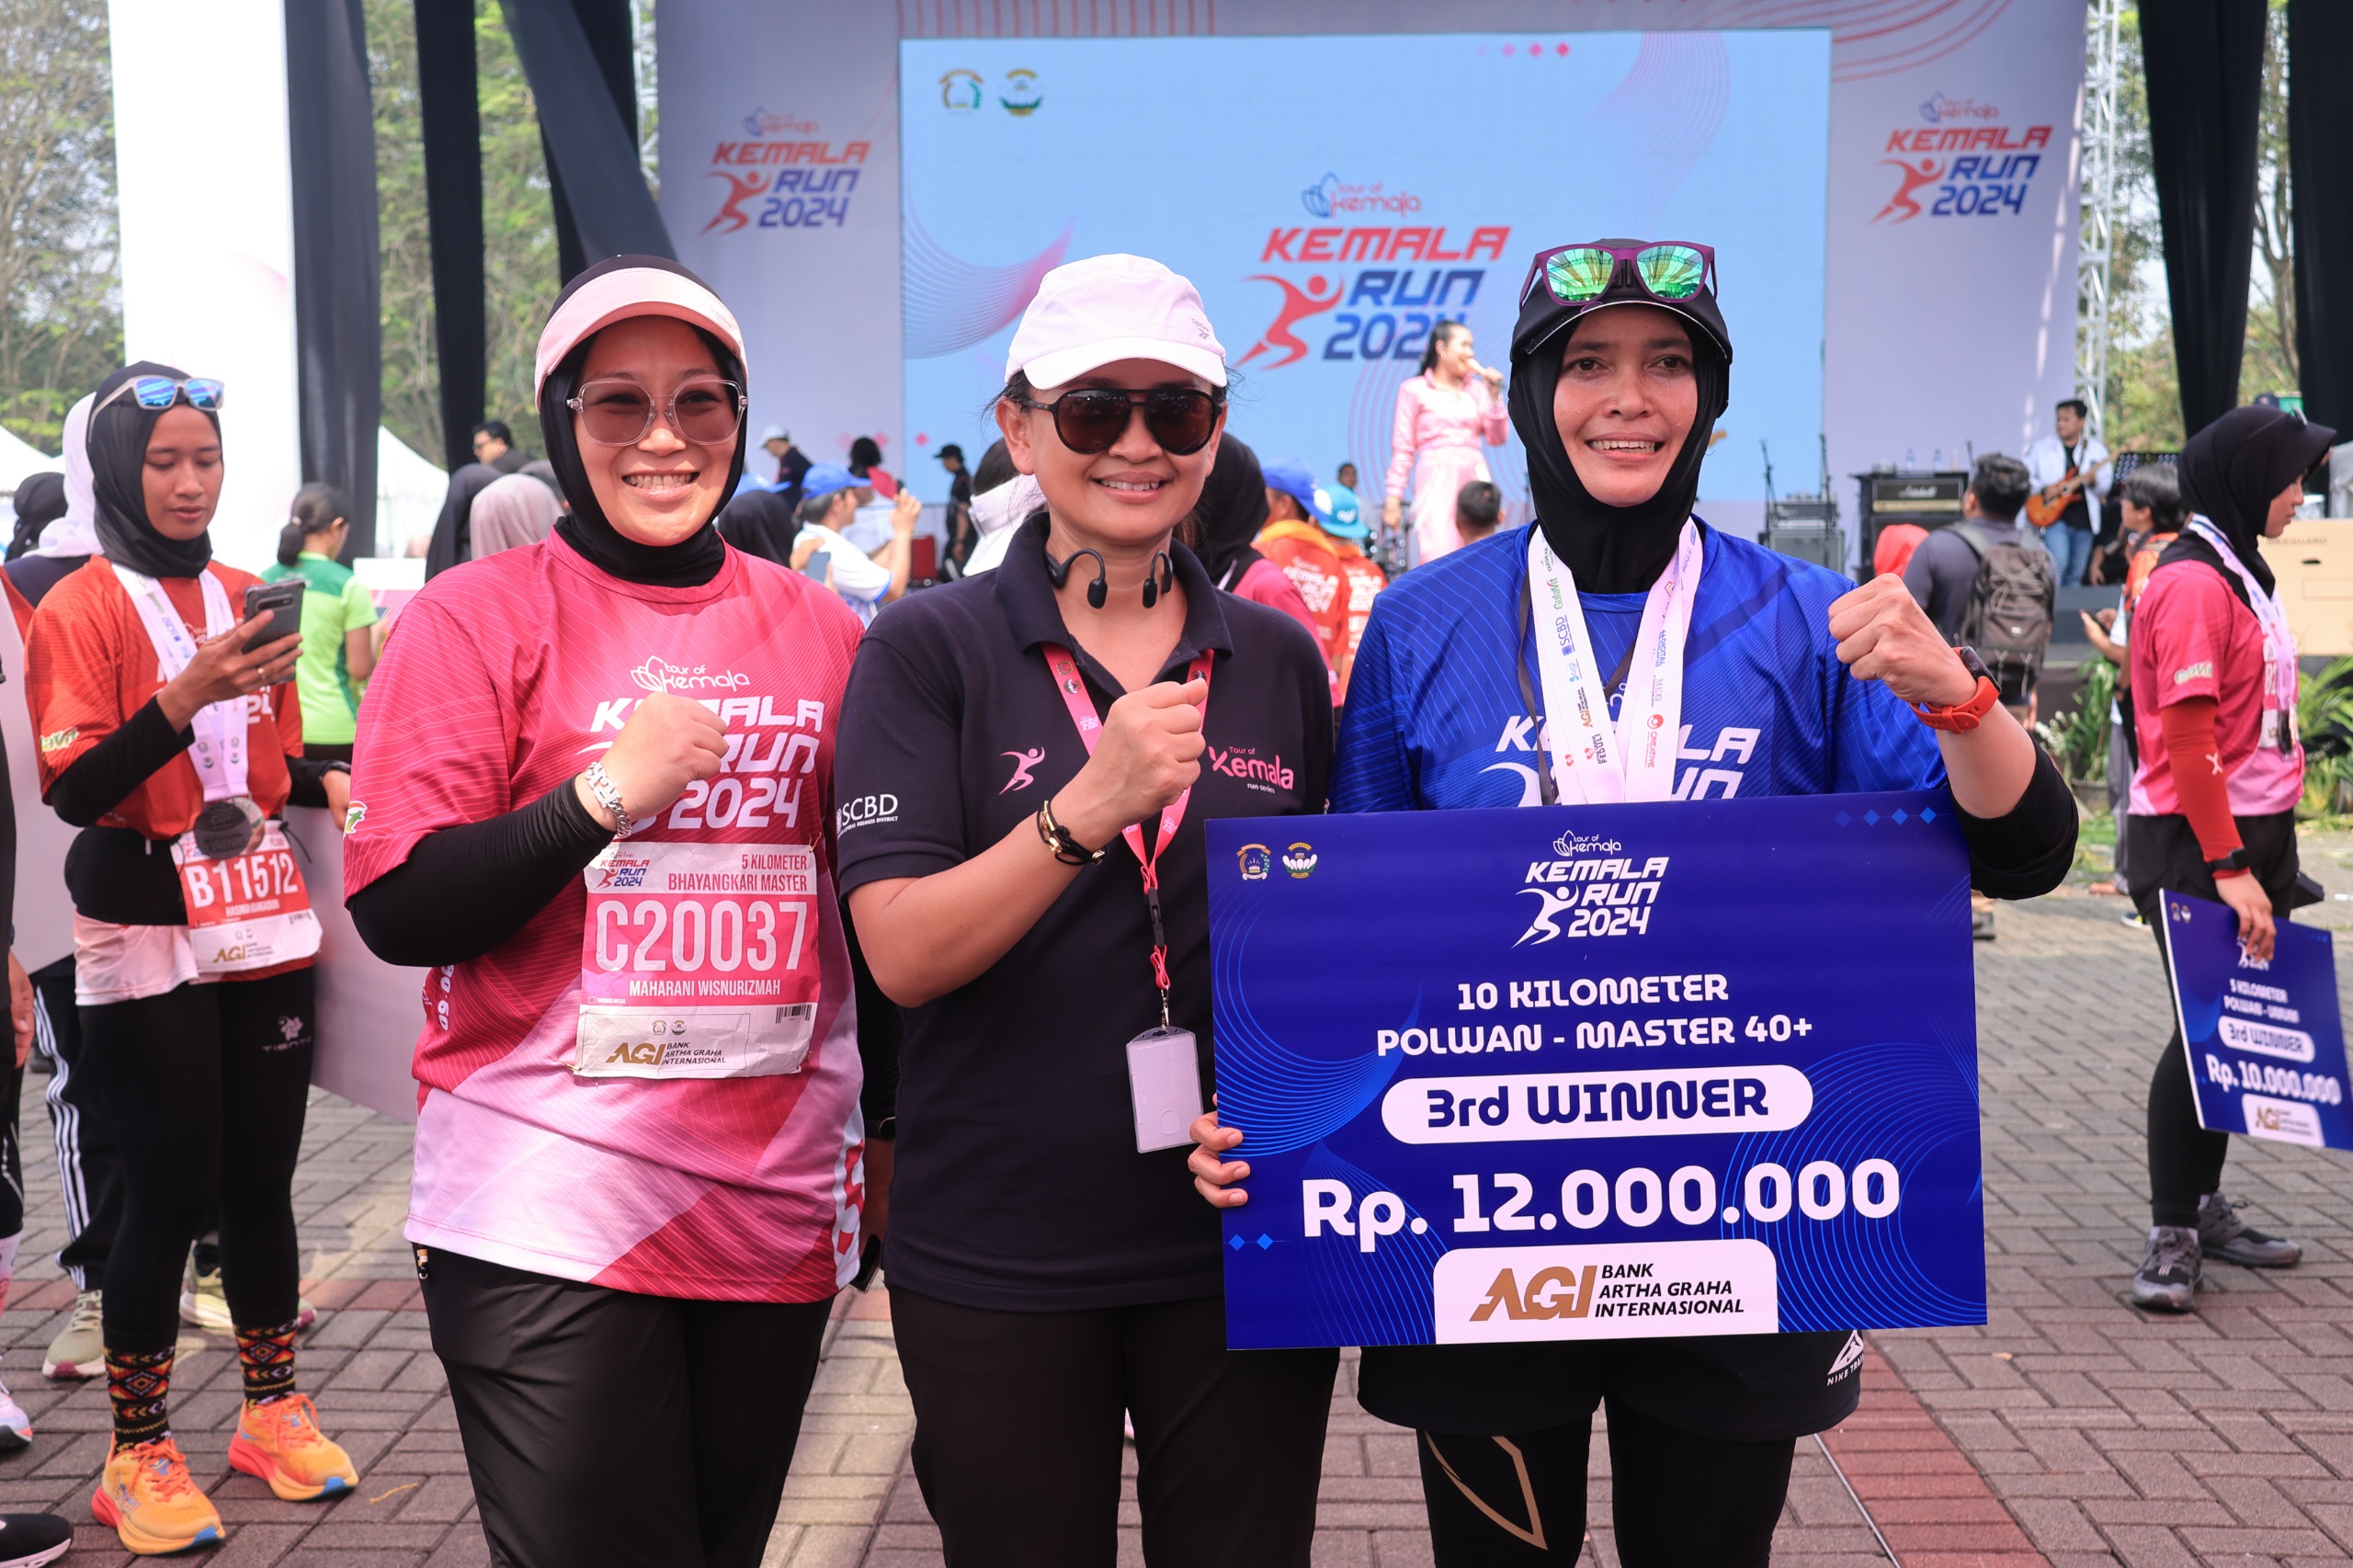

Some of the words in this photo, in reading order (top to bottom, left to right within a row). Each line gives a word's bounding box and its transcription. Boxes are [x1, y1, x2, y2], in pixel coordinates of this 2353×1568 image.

[1885, 126, 2052, 153] KEMALA
[712, 142, 871, 165] KEMALA
[1948, 154, 2041, 179] RUN
[773, 168, 860, 193] RUN
[1931, 184, 2029, 215] 2024
[756, 198, 851, 227] 2024
[1260, 226, 1511, 262] KEMALA
[1347, 269, 1486, 307] RUN
[1547, 576, 1563, 610] GulaVit
[1555, 617, 1571, 646] SCBD
[665, 663, 689, 676] tour
[693, 665, 707, 675] of
[1654, 678, 1664, 701] MEG
[1578, 710, 1593, 728] AGI
[1229, 746, 1245, 755] Tour
[1593, 733, 1607, 764] PEDULI
[1648, 731, 1658, 768] CREATIVE
[1208, 746, 1294, 790] Kemala
[1246, 782, 1259, 790] run
[1259, 784, 1276, 794] series
[668, 778, 802, 829] 2024
[843, 794, 898, 825] SCBD
[857, 818, 876, 826] BUSINESS
[1591, 834, 1599, 842] of
[742, 855, 748, 869] 5
[752, 855, 807, 870] KILOMETER
[1525, 857, 1669, 883] KEMALA
[185, 852, 299, 909] B11512
[614, 877, 643, 886] 2024
[668, 873, 758, 892] BHAYANGKARI
[761, 875, 807, 892] MASTER
[1581, 881, 1661, 906] RUN
[1567, 906, 1651, 938] 2024
[595, 900, 807, 972] C20037
[213, 945, 245, 963] AGI
[629, 980, 695, 997] MAHARANI
[698, 979, 781, 995] WISNURIZMAH
[1458, 983, 1497, 1010] 10
[1510, 974, 1728, 1009] KILOMETER
[667, 1041, 690, 1050] BANK
[1377, 1022, 1542, 1057] POLWAN
[1576, 1017, 1735, 1050] MASTER
[1745, 1015, 1813, 1042] 40+
[2228, 1024, 2248, 1042] 3rd
[2249, 1028, 2304, 1054] WINNER
[605, 1042, 666, 1065] AGI
[662, 1057, 726, 1065] INTERNASIONAL
[2205, 1053, 2240, 1093] Rp.
[2238, 1061, 2342, 1106] 10.000.000
[1427, 1086, 1510, 1129] 3rd
[1527, 1078, 1769, 1123] WINNER
[1303, 1179, 1428, 1253] Rp.
[1452, 1158, 1900, 1233] 12.000.000
[1601, 1263, 1654, 1278] BANK
[1469, 1265, 1597, 1322] AGI
[1598, 1280, 1663, 1298] ARTHA
[1667, 1280, 1733, 1297] GRAHA
[1595, 1297, 1745, 1318] INTERNASIONAL
[1827, 1369, 1848, 1386] NIKE
